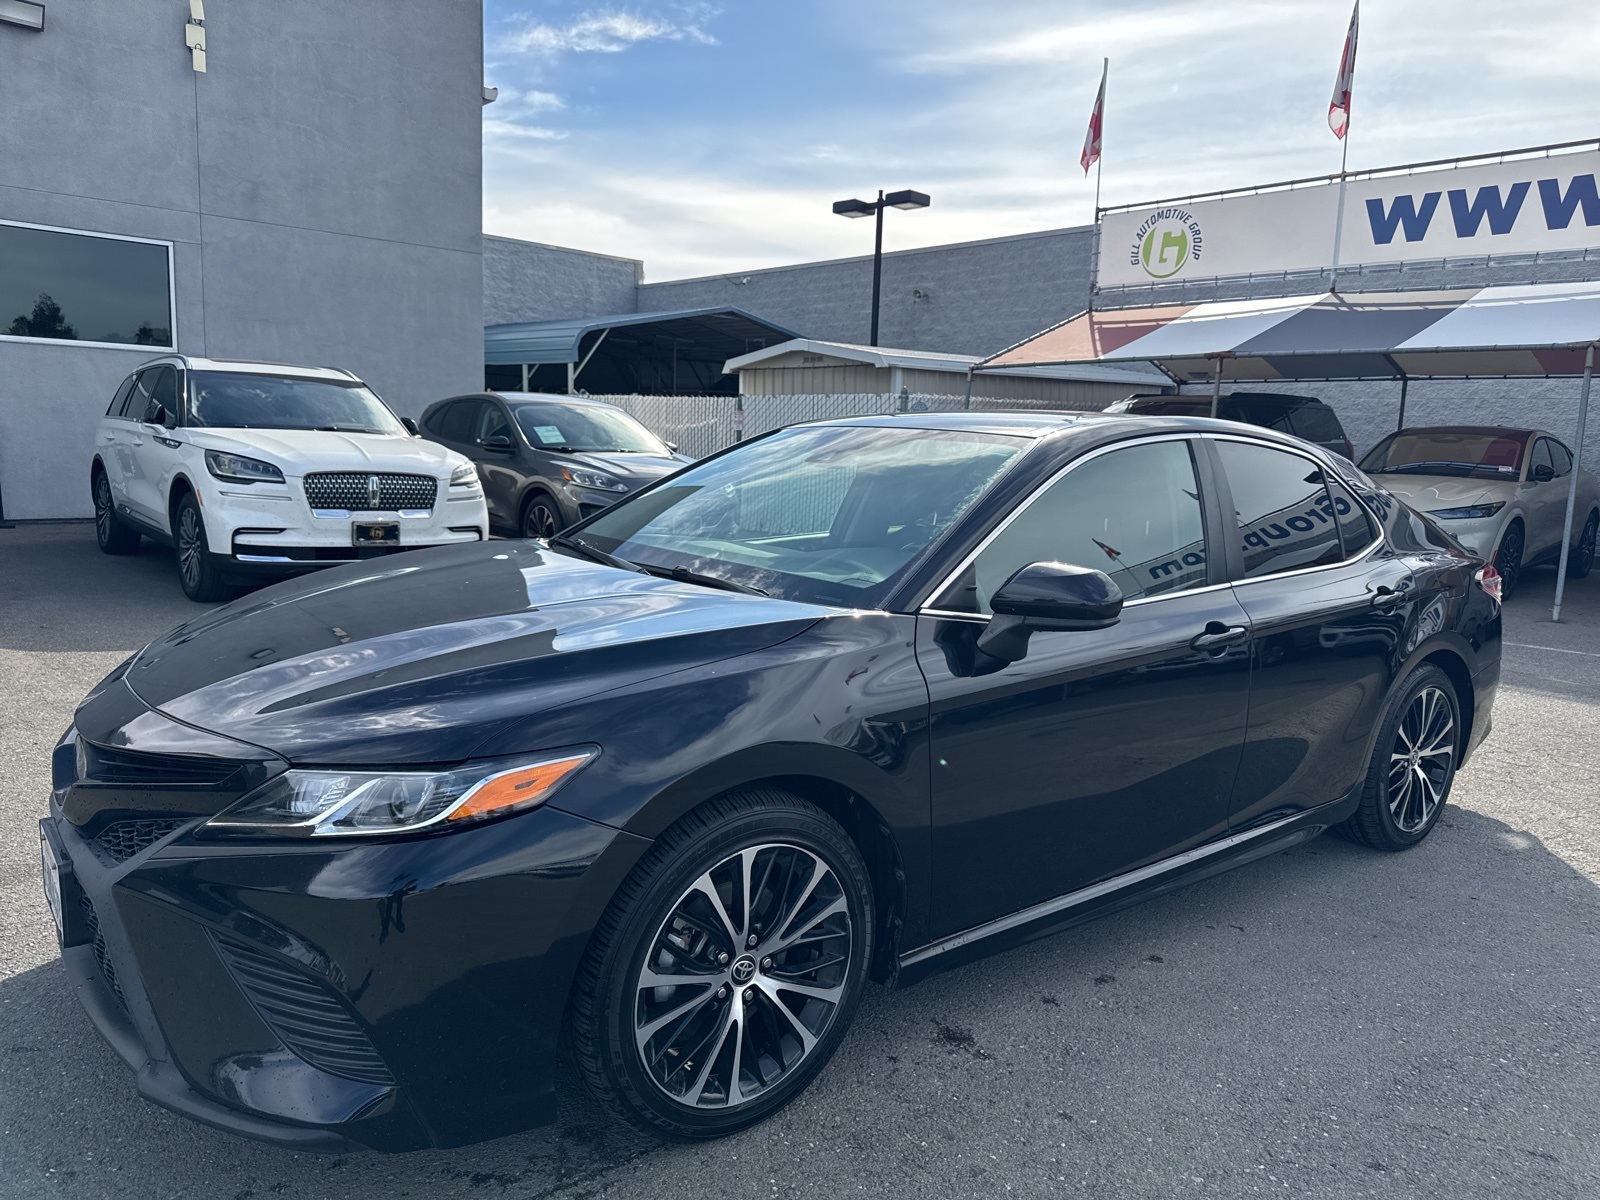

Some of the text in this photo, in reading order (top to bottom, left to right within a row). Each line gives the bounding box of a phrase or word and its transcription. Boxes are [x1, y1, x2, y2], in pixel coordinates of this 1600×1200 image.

[1130, 208, 1203, 266] GILL AUTOMOTIVE GROUP
